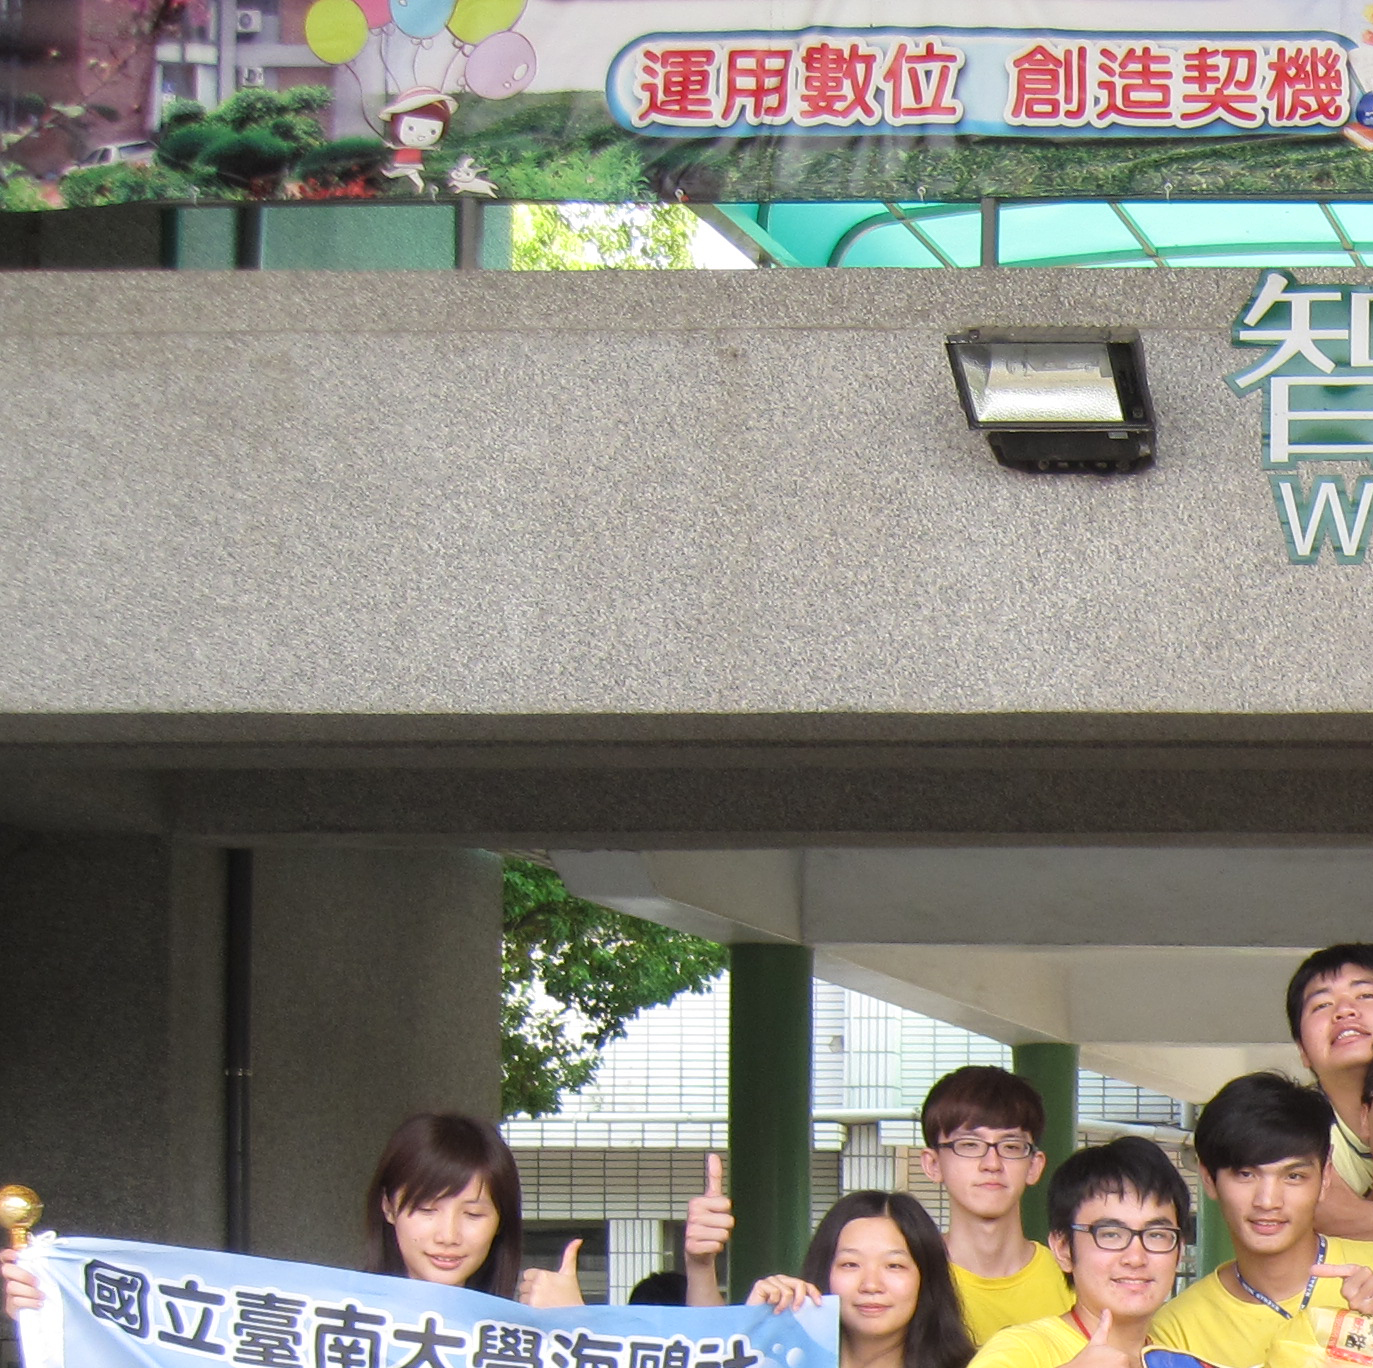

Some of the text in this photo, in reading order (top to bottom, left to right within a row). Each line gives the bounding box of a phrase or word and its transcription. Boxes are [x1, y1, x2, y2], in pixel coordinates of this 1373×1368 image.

[638, 45, 1345, 124] 運用數位 創造契機
